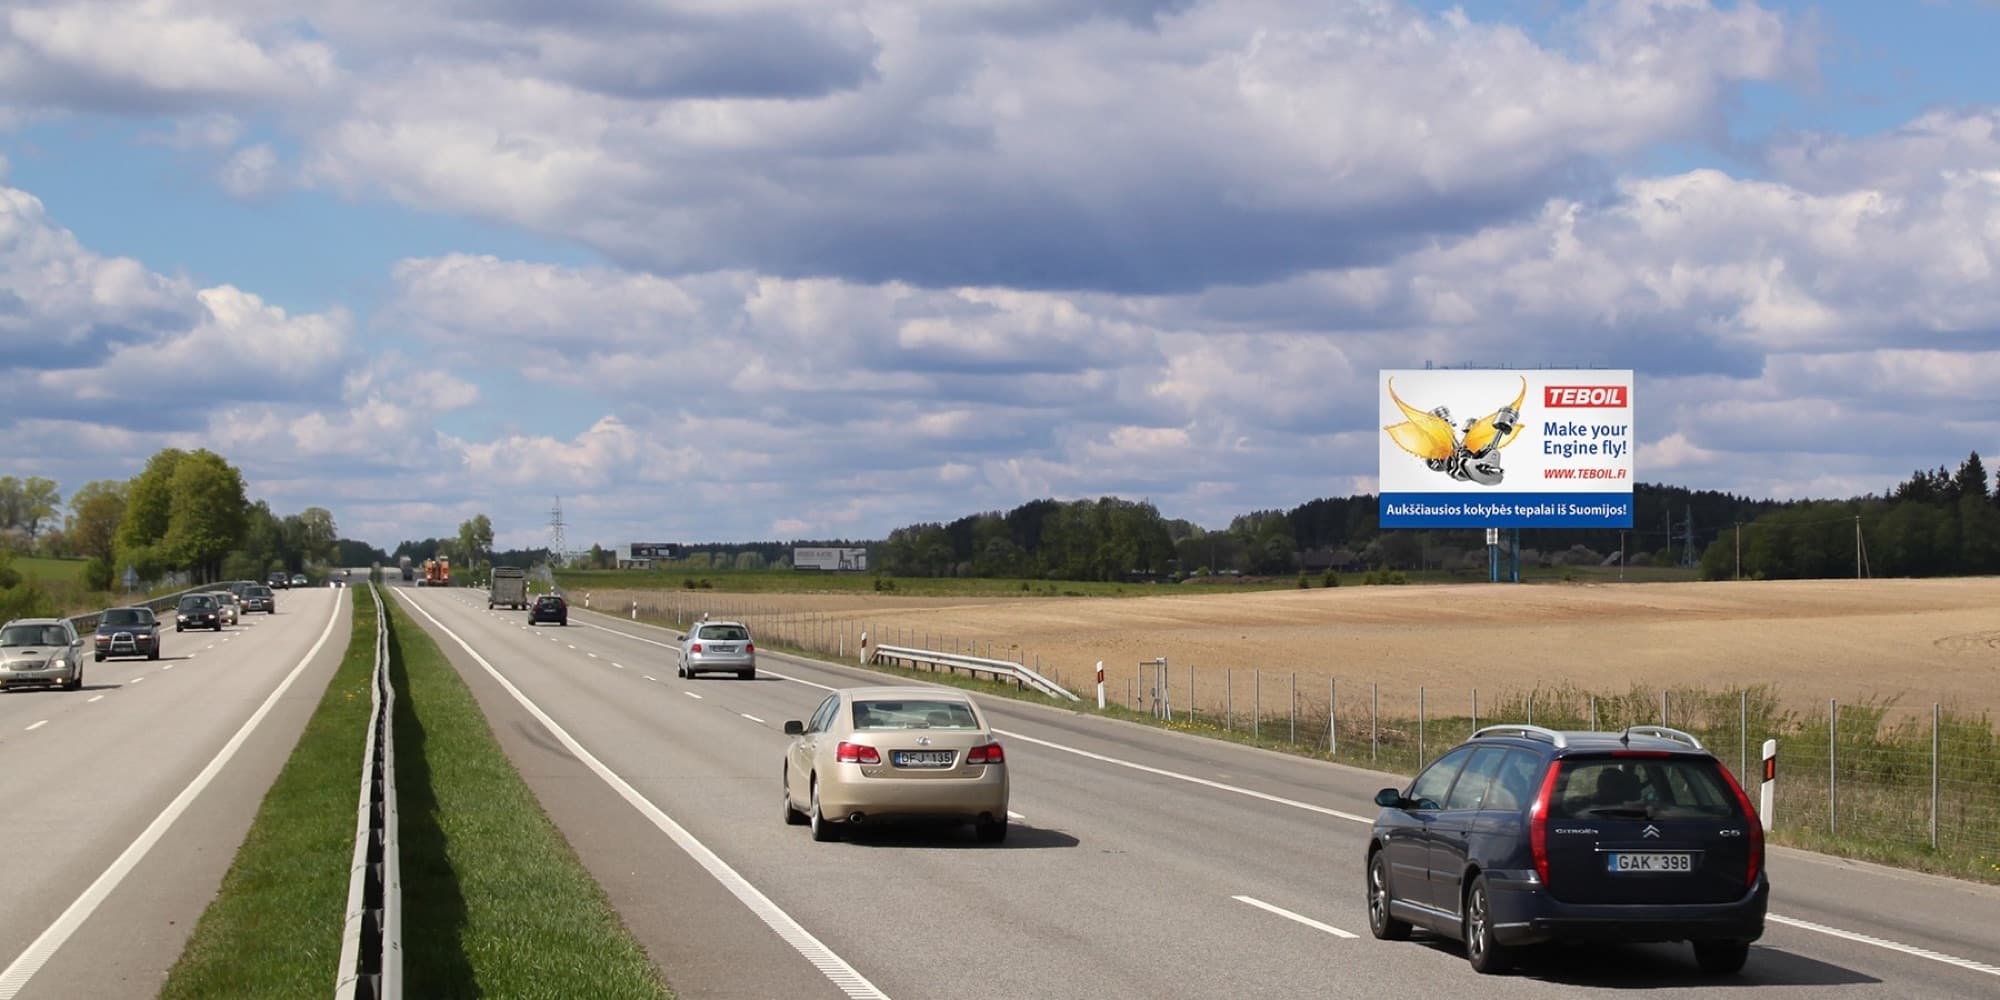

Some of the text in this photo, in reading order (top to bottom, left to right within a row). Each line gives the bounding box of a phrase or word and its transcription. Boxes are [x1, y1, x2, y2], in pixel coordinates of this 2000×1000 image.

[1550, 388, 1622, 405] TEBOIL
[1544, 421, 1628, 440] Make your
[1544, 440, 1627, 458] Engine fly!
[1544, 468, 1627, 479] WWW.TEBOIL.FI
[1386, 503, 1627, 518] Aukščiausios kokybės tepalai iš Suomijos!
[1619, 856, 1689, 869] GAK 398
